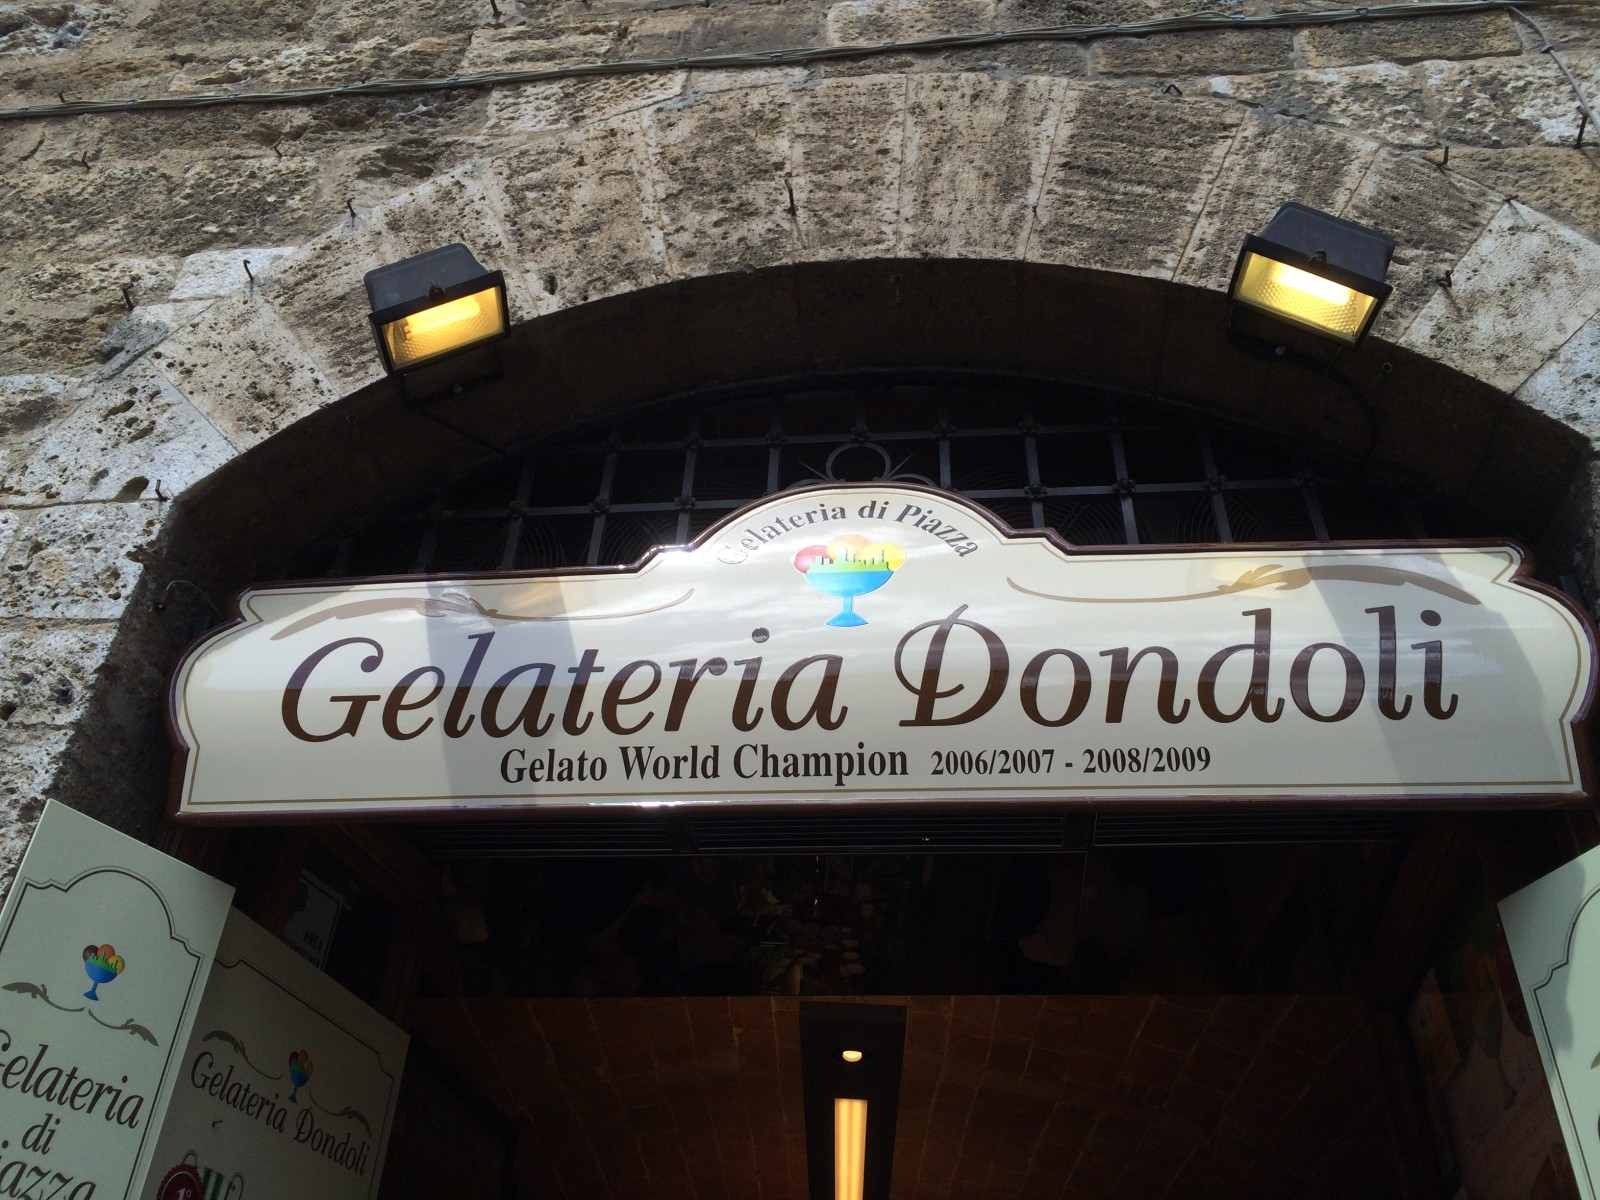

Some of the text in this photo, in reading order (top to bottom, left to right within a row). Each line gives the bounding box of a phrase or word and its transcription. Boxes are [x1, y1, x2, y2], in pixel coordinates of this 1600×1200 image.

[716, 499, 979, 565] Gelateria di Piazza
[280, 603, 1459, 744] Gelateria Dondoli
[500, 748, 608, 784] Gelato
[621, 744, 720, 781] World
[733, 741, 909, 787] Champion
[930, 749, 1055, 776] 2006/2007
[1083, 746, 1212, 774] 2008/2009
[0, 1028, 145, 1129] elateria
[190, 1050, 371, 1177] Gelateria Dondoli
[21, 1113, 61, 1155] di
